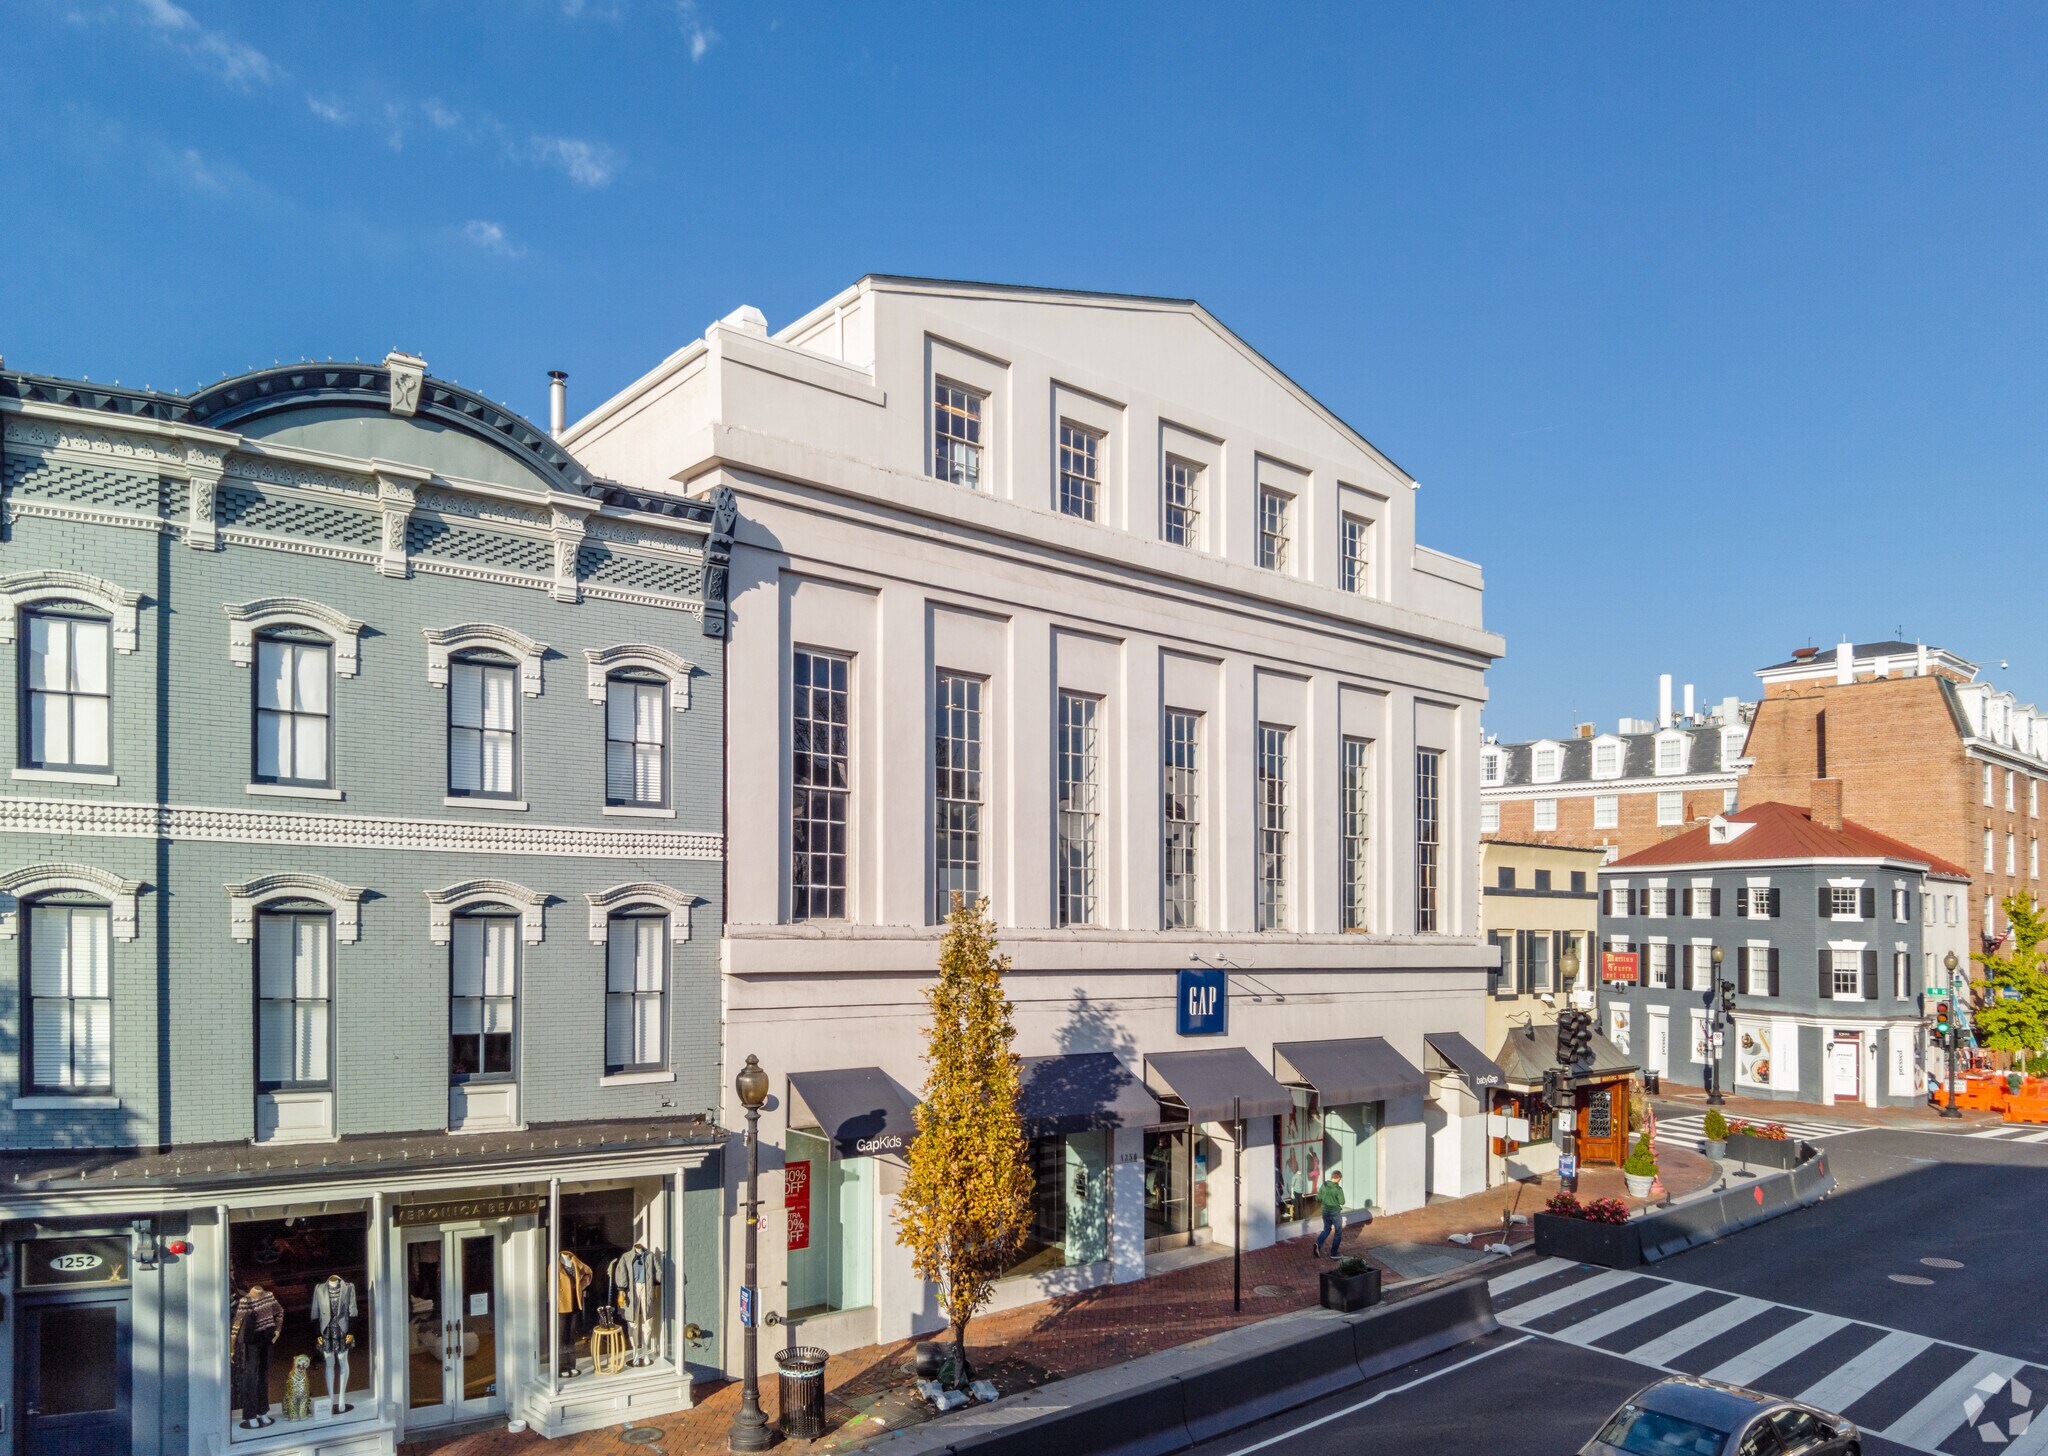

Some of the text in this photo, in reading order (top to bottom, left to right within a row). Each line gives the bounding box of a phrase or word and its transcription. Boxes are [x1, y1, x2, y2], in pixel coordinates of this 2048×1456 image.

[1189, 986, 1217, 1016] GAP
[856, 1135, 902, 1153] GapKids
[488, 1199, 538, 1213] BEARD
[787, 1212, 801, 1220] TRA
[57, 1256, 95, 1269] 1252
